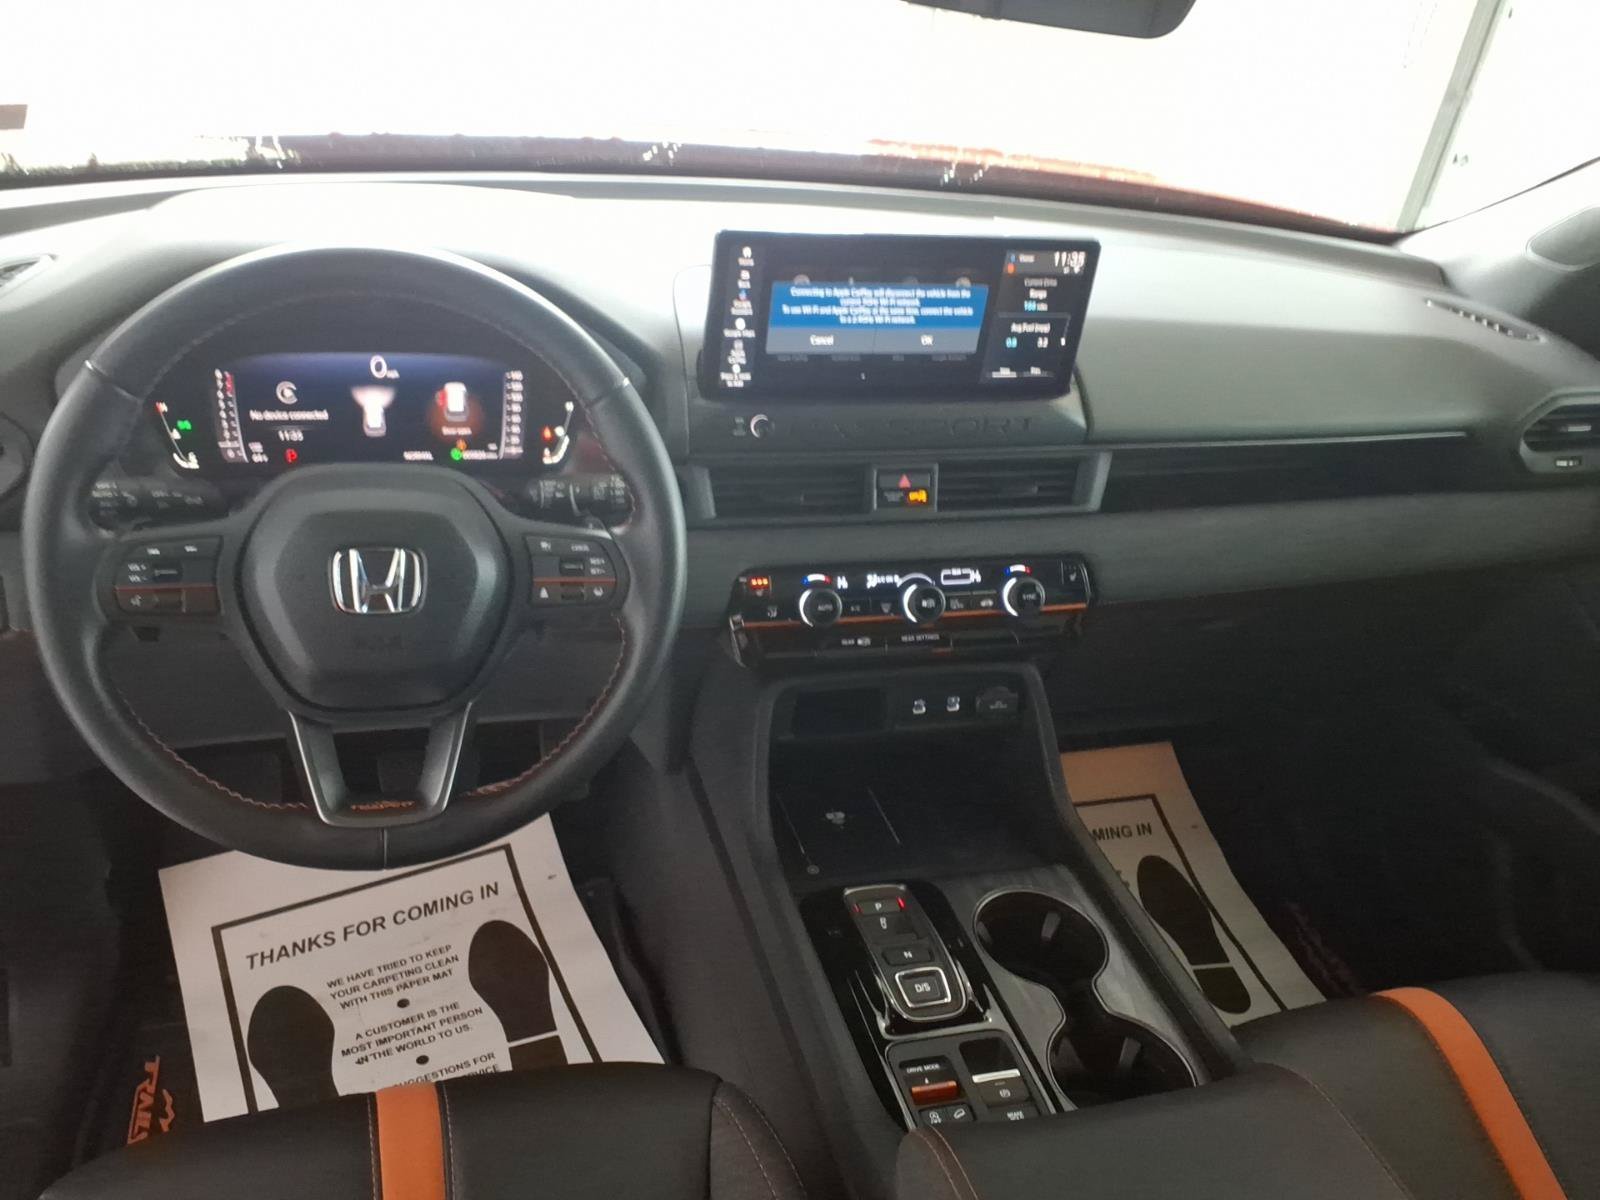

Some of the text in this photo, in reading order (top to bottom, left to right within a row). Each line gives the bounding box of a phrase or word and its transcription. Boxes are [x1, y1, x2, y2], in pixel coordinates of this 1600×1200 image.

[1136, 822, 1152, 836] IN
[246, 882, 500, 970] THANKS FOR COMING IN
[326, 944, 452, 988] WE HAVE TRIED TO KEEP
[330, 954, 459, 1000] YOUR CARPETING CLEAN
[339, 969, 454, 1010] WITH THIS PAPER MAT
[341, 1007, 484, 1057] MOST IMPORTANT PERSON
[365, 1013, 425, 1037] CUSTOMER
[427, 1009, 437, 1017] IS
[440, 1002, 460, 1014] THE
[370, 1048, 393, 1060] THE
[395, 1034, 436, 1053] WORLD
[438, 1028, 452, 1040] TO
[473, 1052, 496, 1065] FOR
